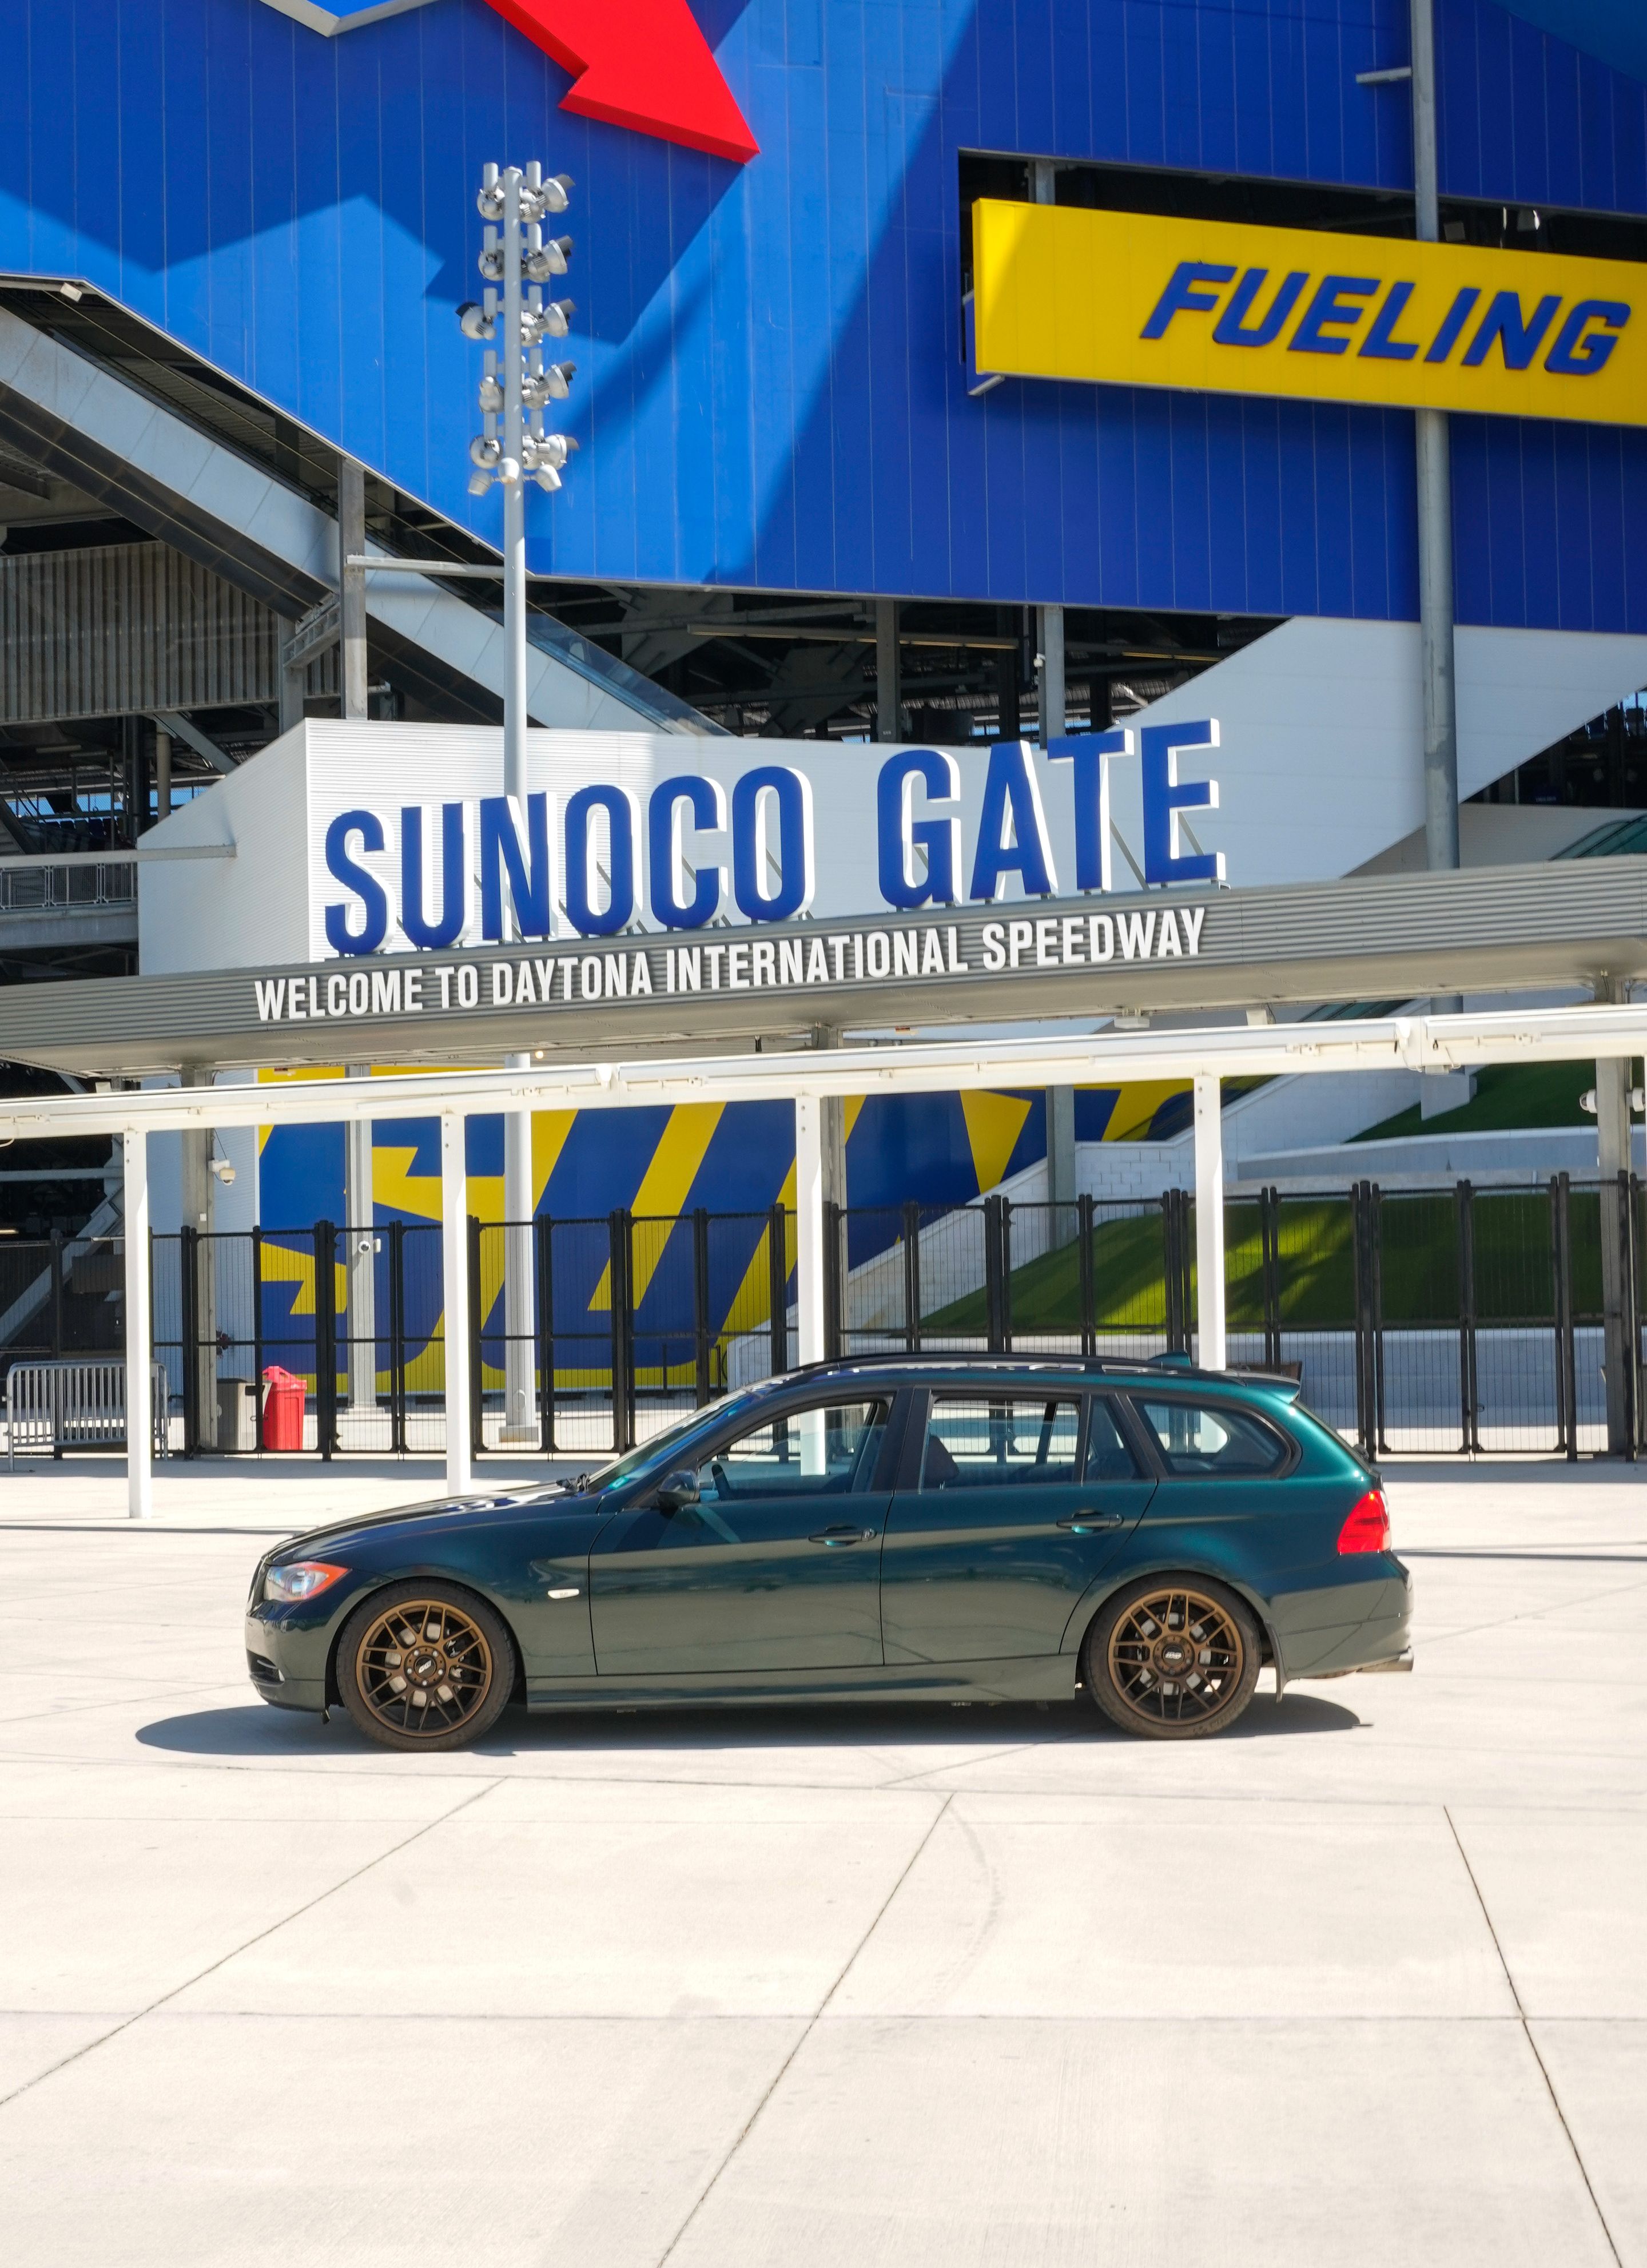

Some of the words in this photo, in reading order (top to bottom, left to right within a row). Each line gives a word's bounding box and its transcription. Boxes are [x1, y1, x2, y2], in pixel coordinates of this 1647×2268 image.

[1139, 261, 1632, 375] FUELING
[324, 766, 815, 956] SUNOCO
[877, 717, 1226, 912] GATE
[254, 968, 424, 1022] WELCOME
[435, 966, 479, 1010] TO
[491, 951, 653, 1006] DAYTONA
[665, 926, 969, 994] INTERNATIONAL
[981, 907, 1206, 971] SPEEDWAY
